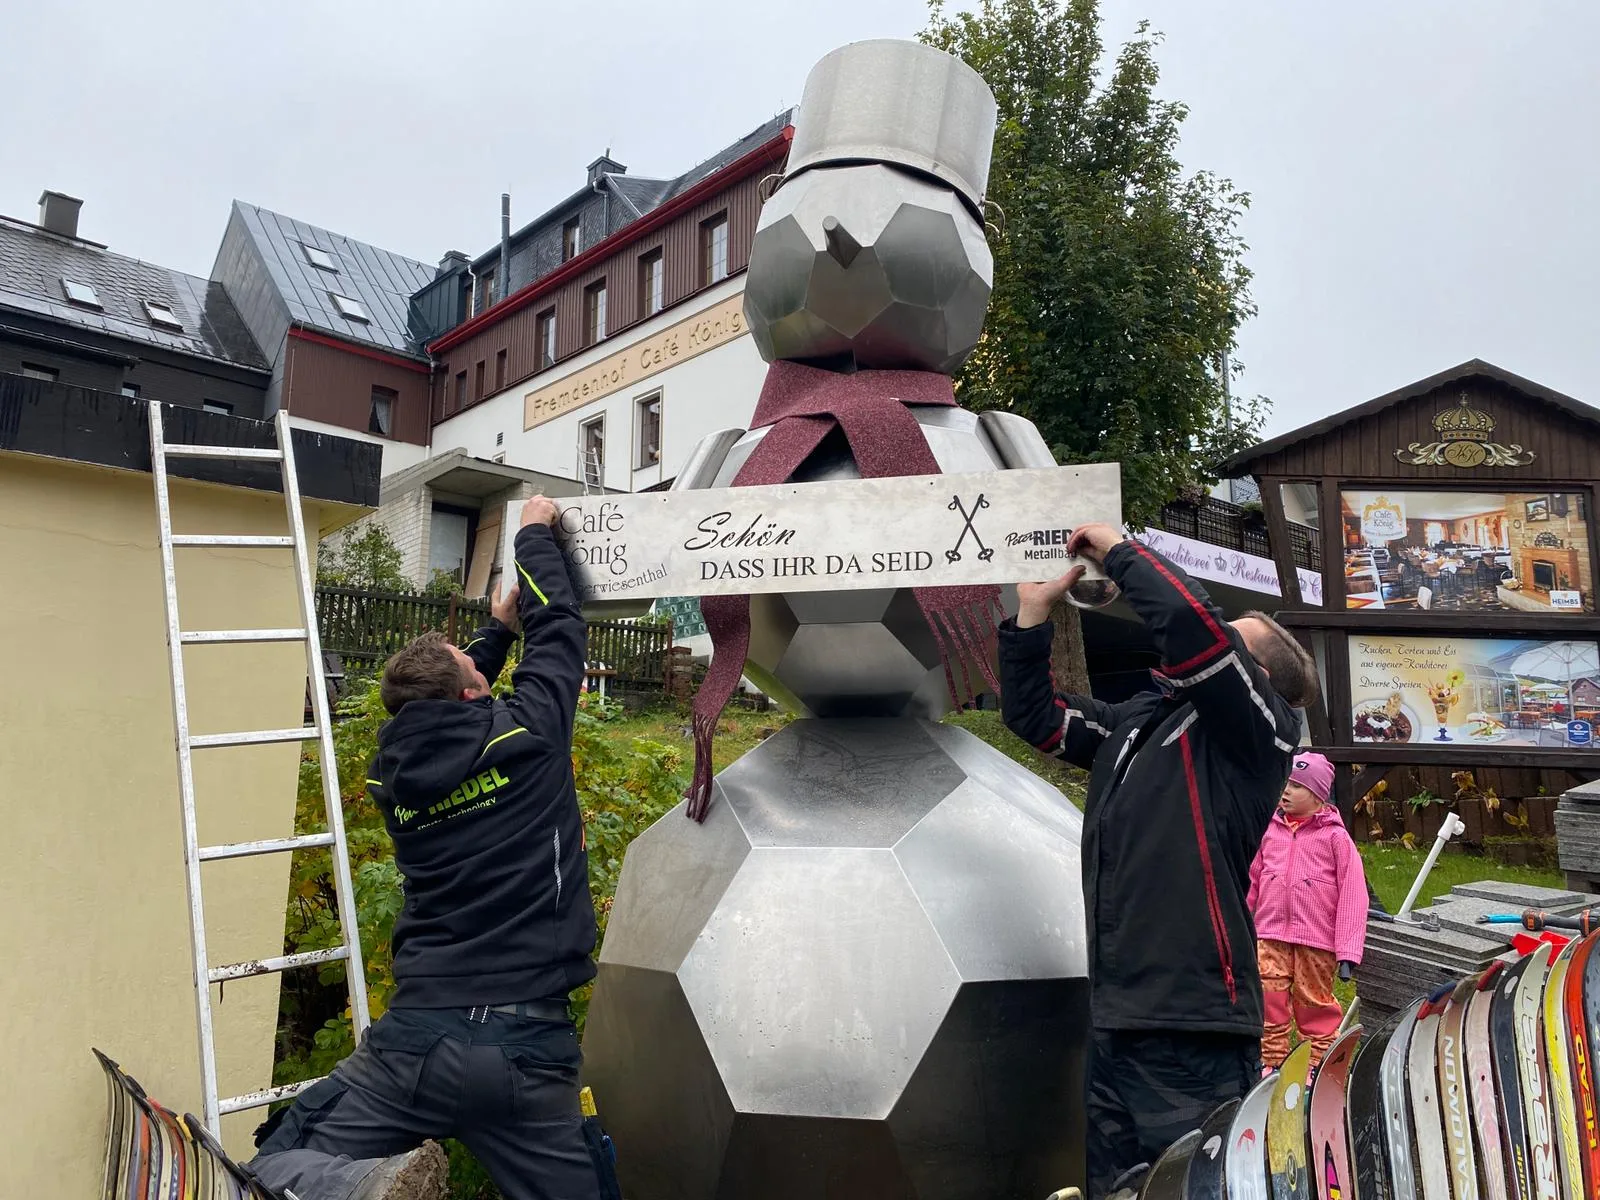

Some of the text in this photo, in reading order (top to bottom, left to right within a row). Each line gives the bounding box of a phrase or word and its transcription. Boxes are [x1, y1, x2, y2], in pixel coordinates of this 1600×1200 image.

[534, 311, 743, 419] Fremdenhof Café König
[560, 503, 625, 535] Café
[684, 511, 797, 551] Schön
[1033, 529, 1074, 546] RIED
[571, 538, 629, 576] önig
[700, 550, 934, 581] DASS IHR DA SEID
[576, 563, 669, 594] erwiesenthal
[1575, 1033, 1598, 1150] HEAD
